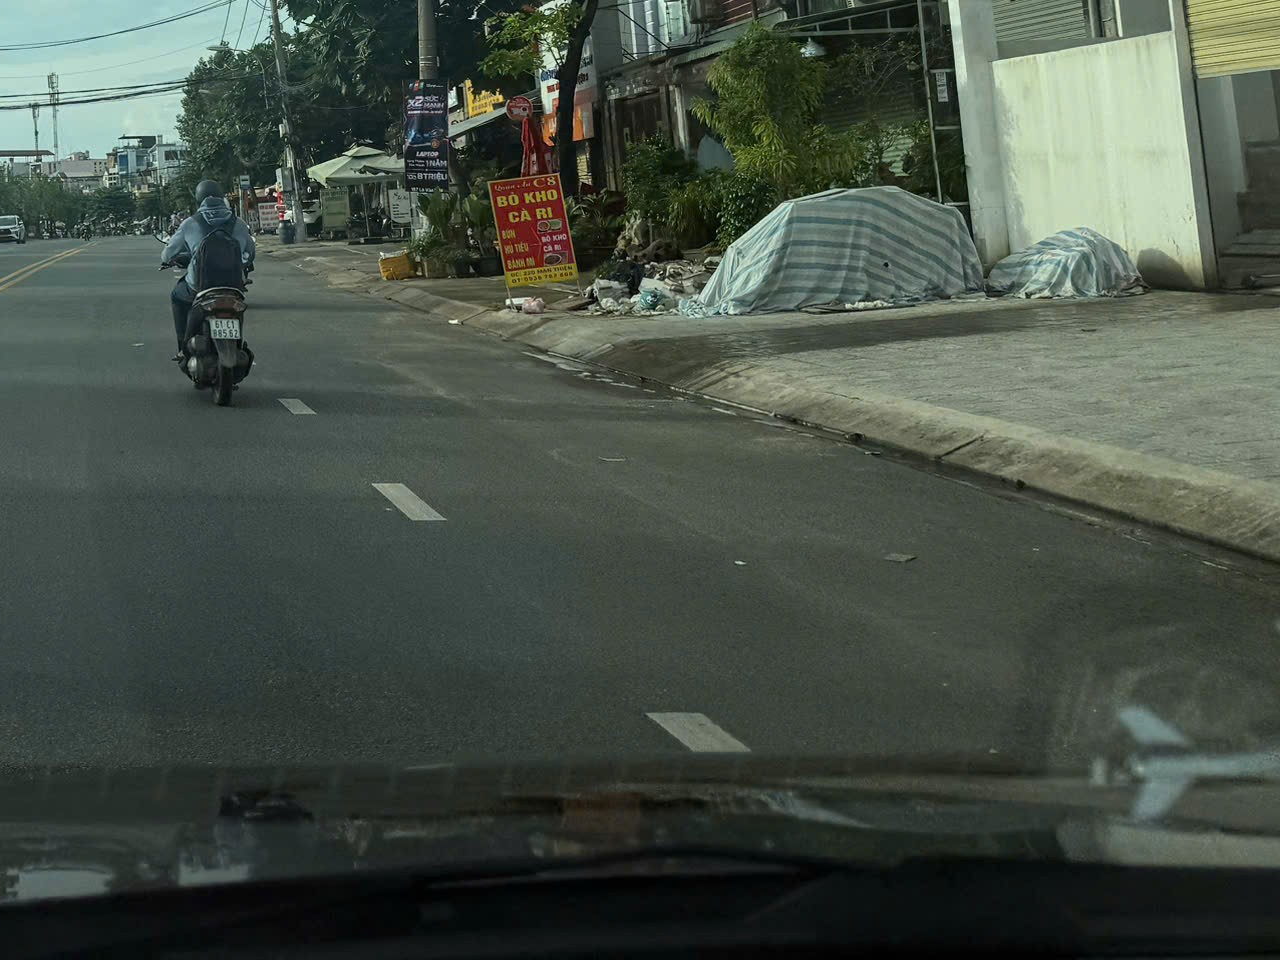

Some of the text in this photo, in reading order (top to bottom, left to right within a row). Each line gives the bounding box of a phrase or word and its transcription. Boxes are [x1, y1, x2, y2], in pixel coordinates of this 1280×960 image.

[533, 176, 556, 188] C8
[496, 189, 558, 208] BÒ KHO
[508, 207, 553, 223] CÀ RI
